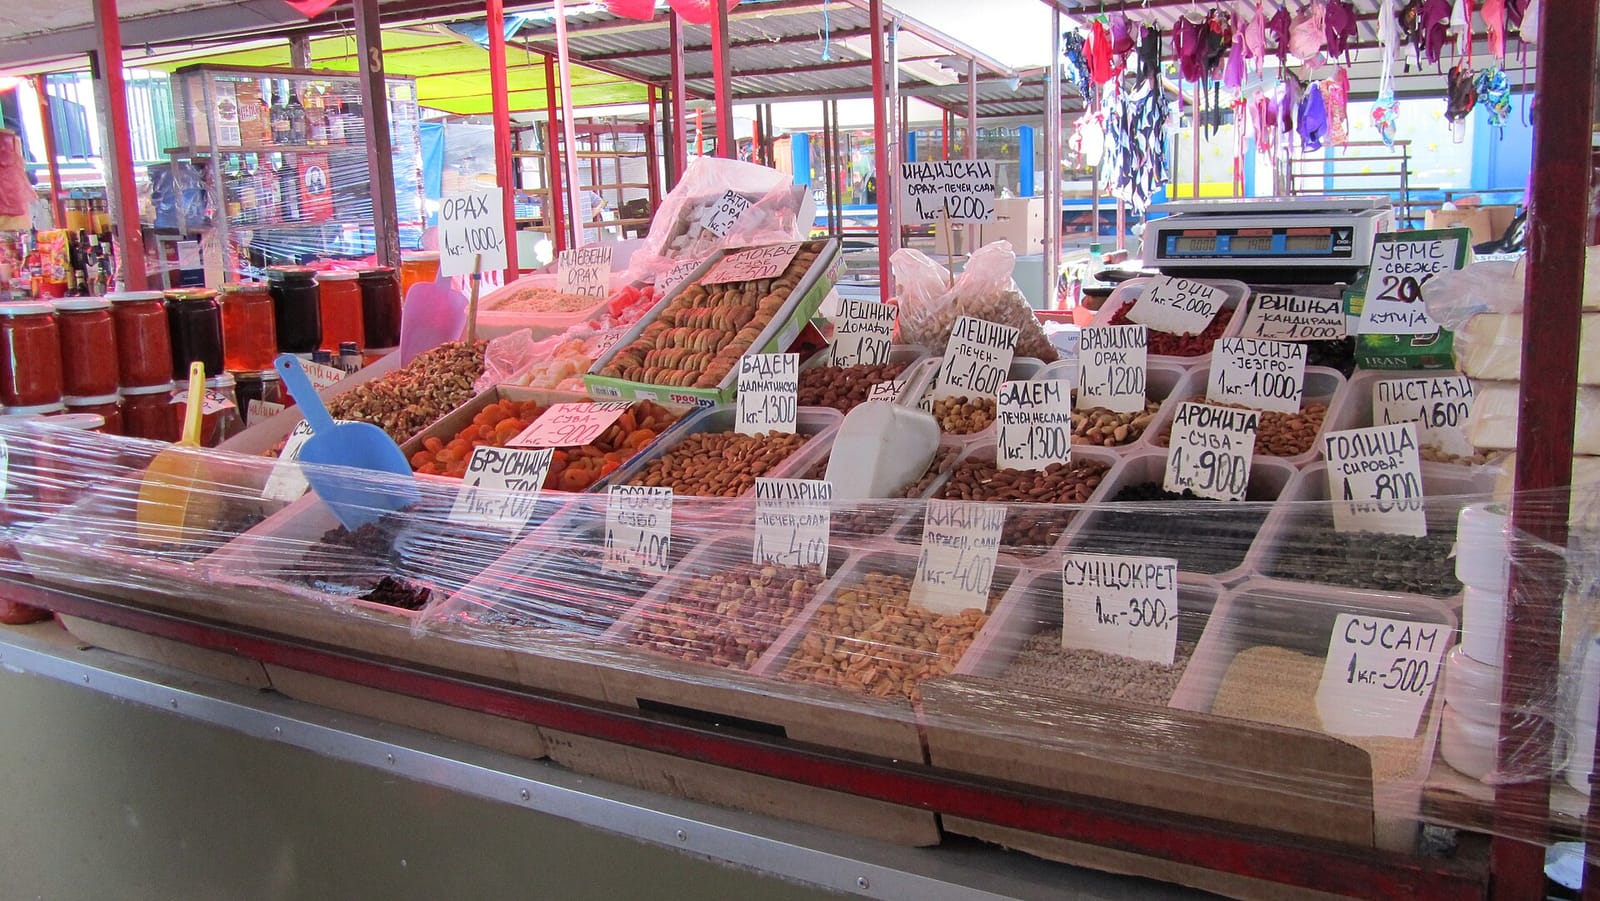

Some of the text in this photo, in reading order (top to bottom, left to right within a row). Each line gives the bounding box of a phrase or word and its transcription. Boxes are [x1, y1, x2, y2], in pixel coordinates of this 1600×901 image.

[902, 160, 991, 181] ИНДИЈСКИ
[443, 194, 488, 220] ОРАХ
[1380, 240, 1444, 261] УРМЕ
[568, 266, 599, 285] ОРАХ
[836, 298, 896, 321] ЛЕШНИК
[1259, 295, 1340, 315] ВИШЊА
[952, 317, 1019, 353] ЛЕШНИК
[1080, 326, 1148, 351] БРАЗИЛСКИ
[1094, 351, 1127, 366] ОРАХ
[1222, 337, 1303, 360] КАЈСИЈА
[1364, 356, 1408, 366] IRAN
[742, 354, 795, 379] БАДЕМ
[999, 381, 1061, 409] БАДЕМ
[1378, 378, 1473, 402] ПИСТАЋИ
[1174, 403, 1258, 435] АРОНИЈА
[1325, 427, 1415, 462] ГОЛИЦА
[469, 448, 553, 480] БРУСНИЦА
[1064, 559, 1176, 591] СУНЦОКРЕТ
[1344, 618, 1439, 653] СУСАМ
